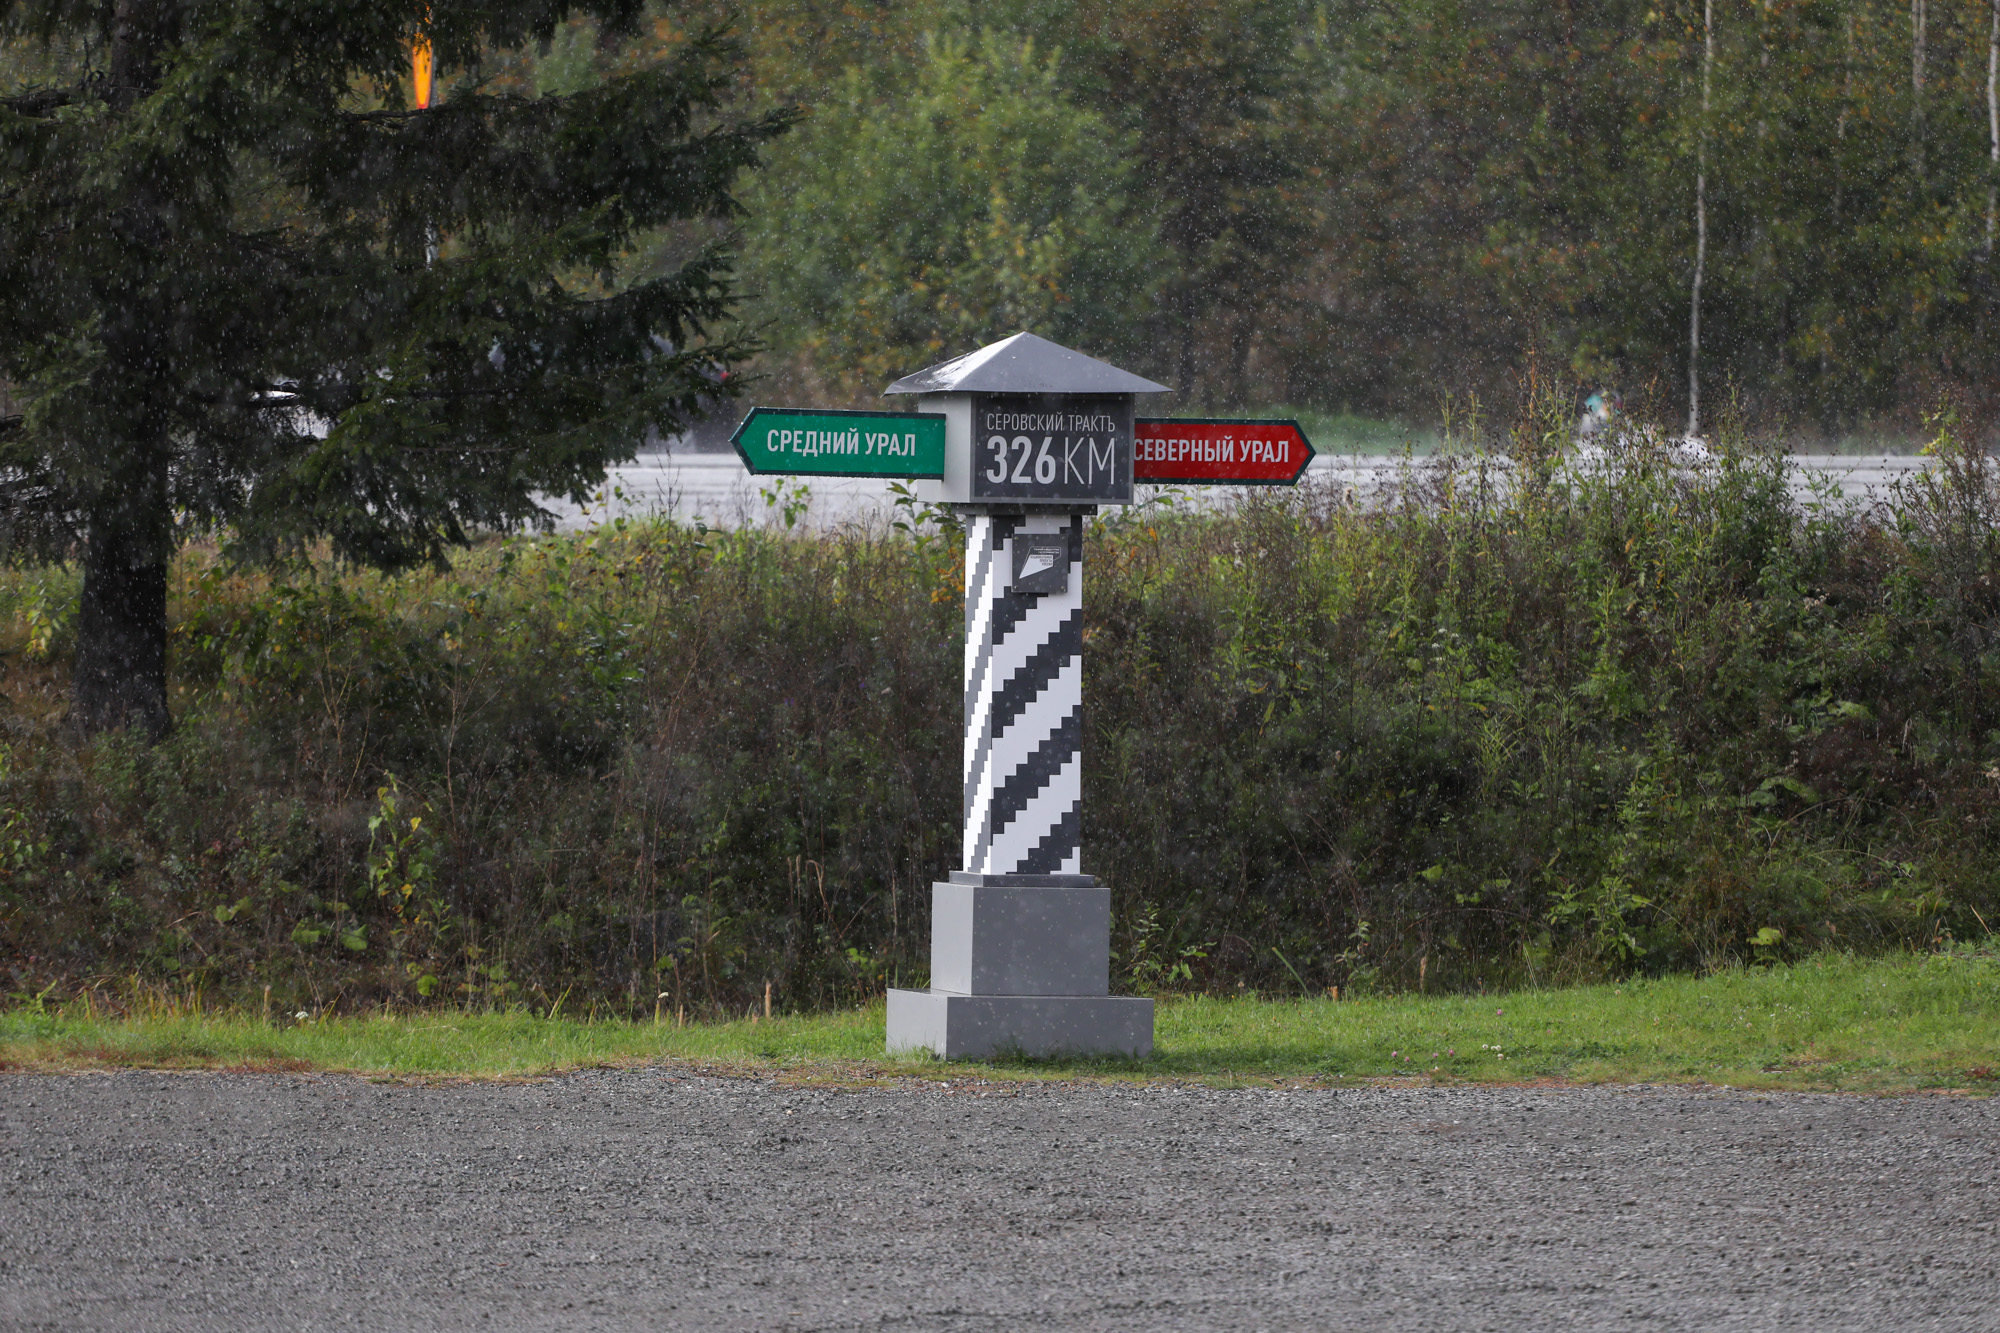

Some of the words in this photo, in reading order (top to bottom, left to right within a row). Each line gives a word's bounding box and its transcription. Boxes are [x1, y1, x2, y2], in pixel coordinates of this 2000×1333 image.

[986, 411, 1063, 432] СЕРОВСКИЙ
[1067, 413, 1116, 432] ТРАКТЪ
[766, 427, 860, 458] СРЕДНИЙ
[864, 432, 916, 457] УРАЛ
[1133, 435, 1234, 462] СЕВЕРНЫЙ
[1239, 440, 1290, 463] УРАЛ
[986, 435, 1057, 485] 326
[1063, 436, 1115, 485] КМ
